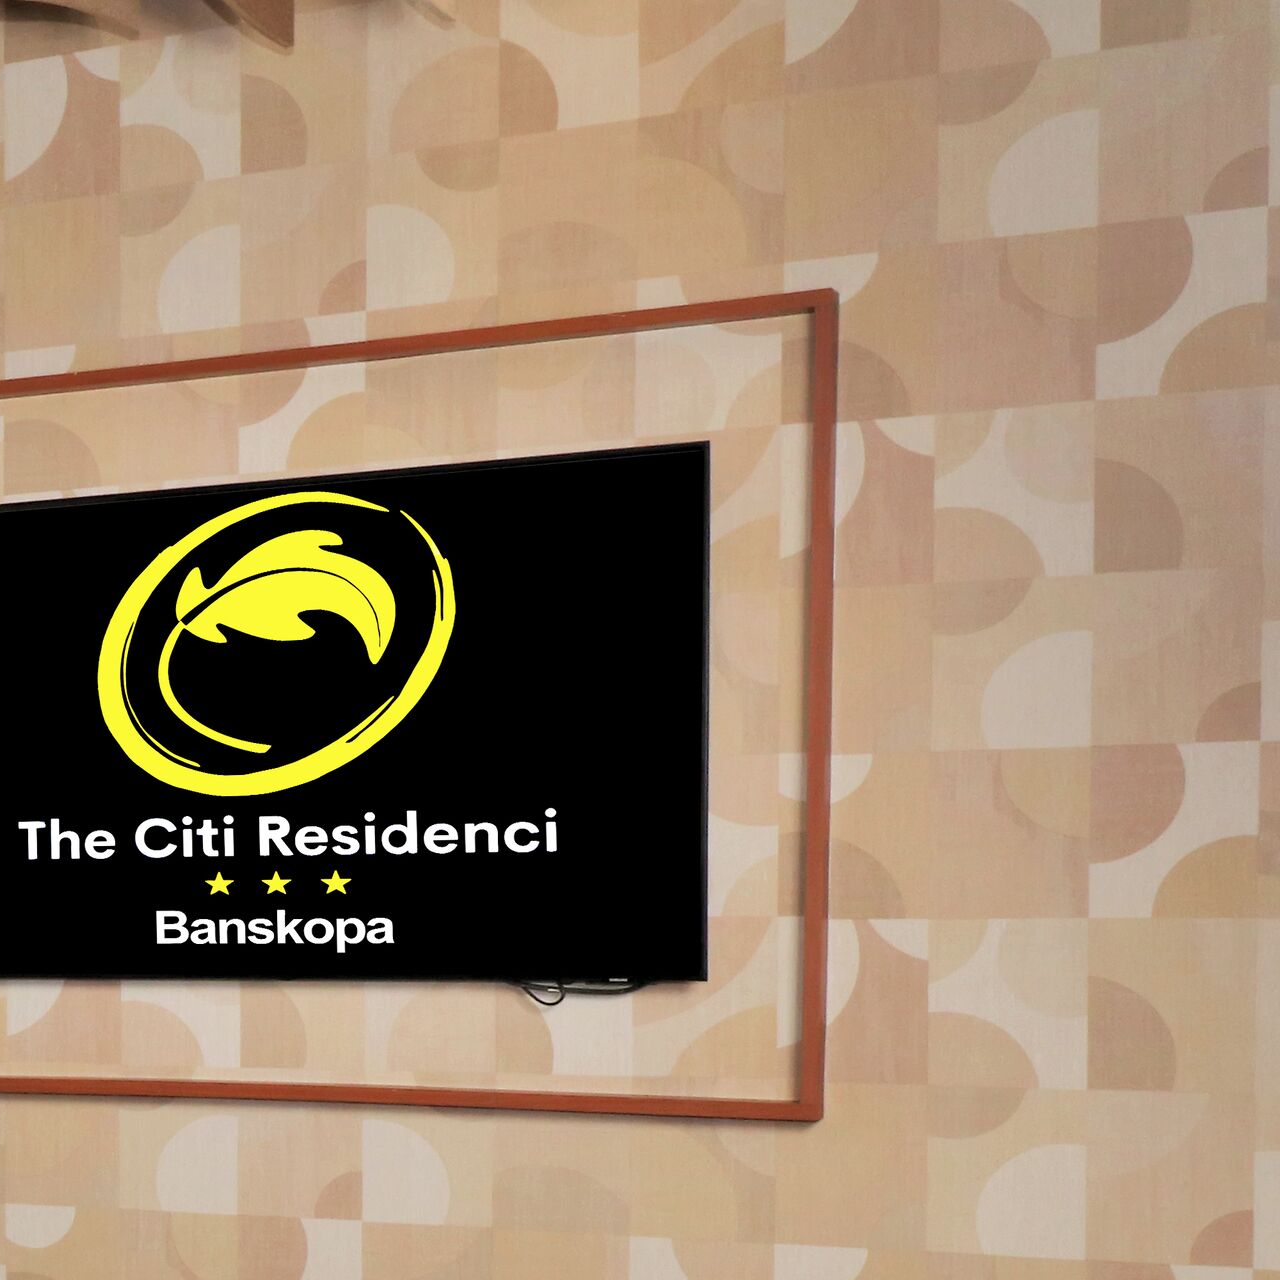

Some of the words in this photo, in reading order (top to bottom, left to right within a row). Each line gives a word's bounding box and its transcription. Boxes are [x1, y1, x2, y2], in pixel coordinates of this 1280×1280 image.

[18, 818, 116, 861] The
[134, 814, 235, 859] Citi
[259, 808, 558, 858] Residenci
[155, 910, 395, 954] Banskopa
